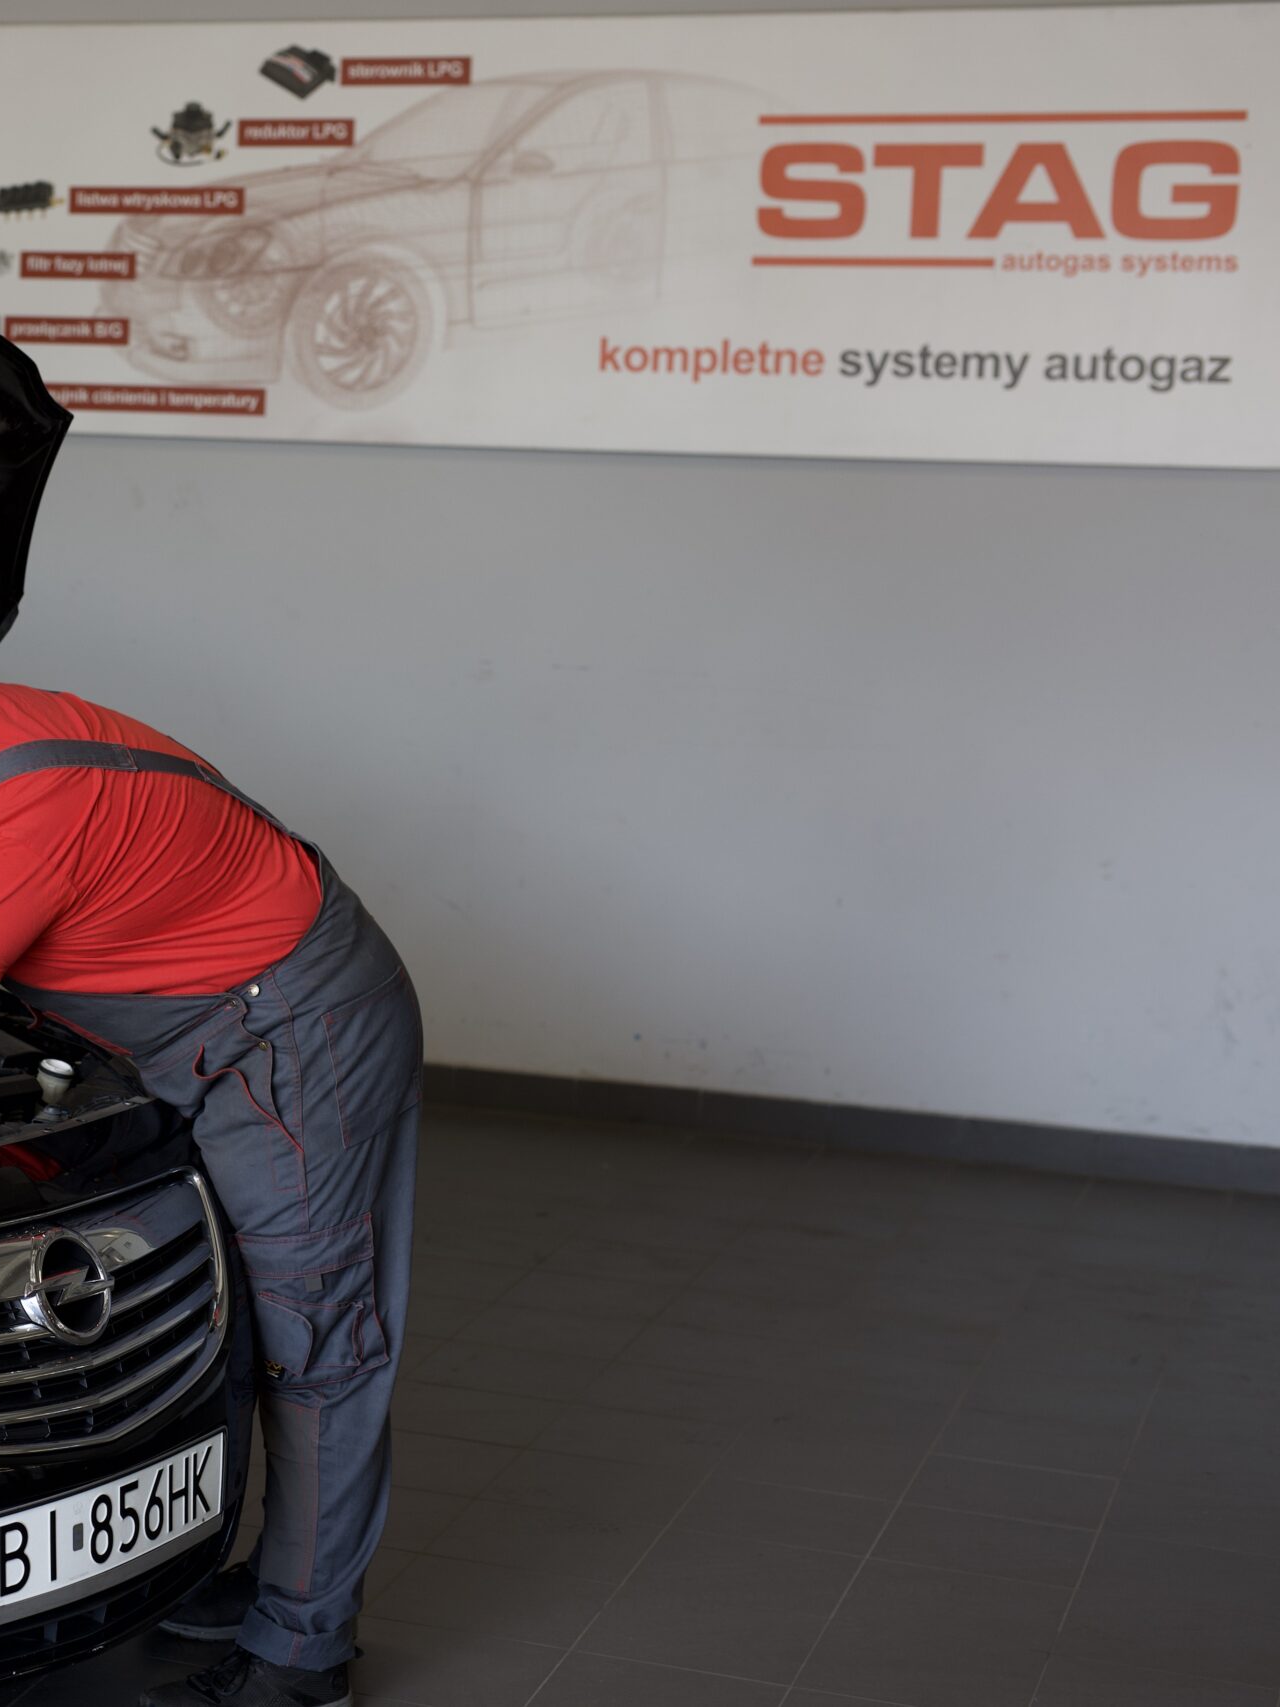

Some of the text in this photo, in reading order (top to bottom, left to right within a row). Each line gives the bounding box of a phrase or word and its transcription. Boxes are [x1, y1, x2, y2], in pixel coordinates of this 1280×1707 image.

[348, 60, 464, 79] sterownik LPG
[244, 122, 347, 140] reduktor LPG
[75, 191, 239, 211] listwa wtryskowa LPG
[757, 140, 1241, 240] STAG
[26, 256, 51, 272] filtr
[54, 256, 85, 275] fazy
[1002, 252, 1238, 277] autogas systems
[599, 337, 1233, 392] kompletne systemy autogaz
[168, 390, 260, 412] temperatury
[0, 1445, 212, 1598] BI 856HK
